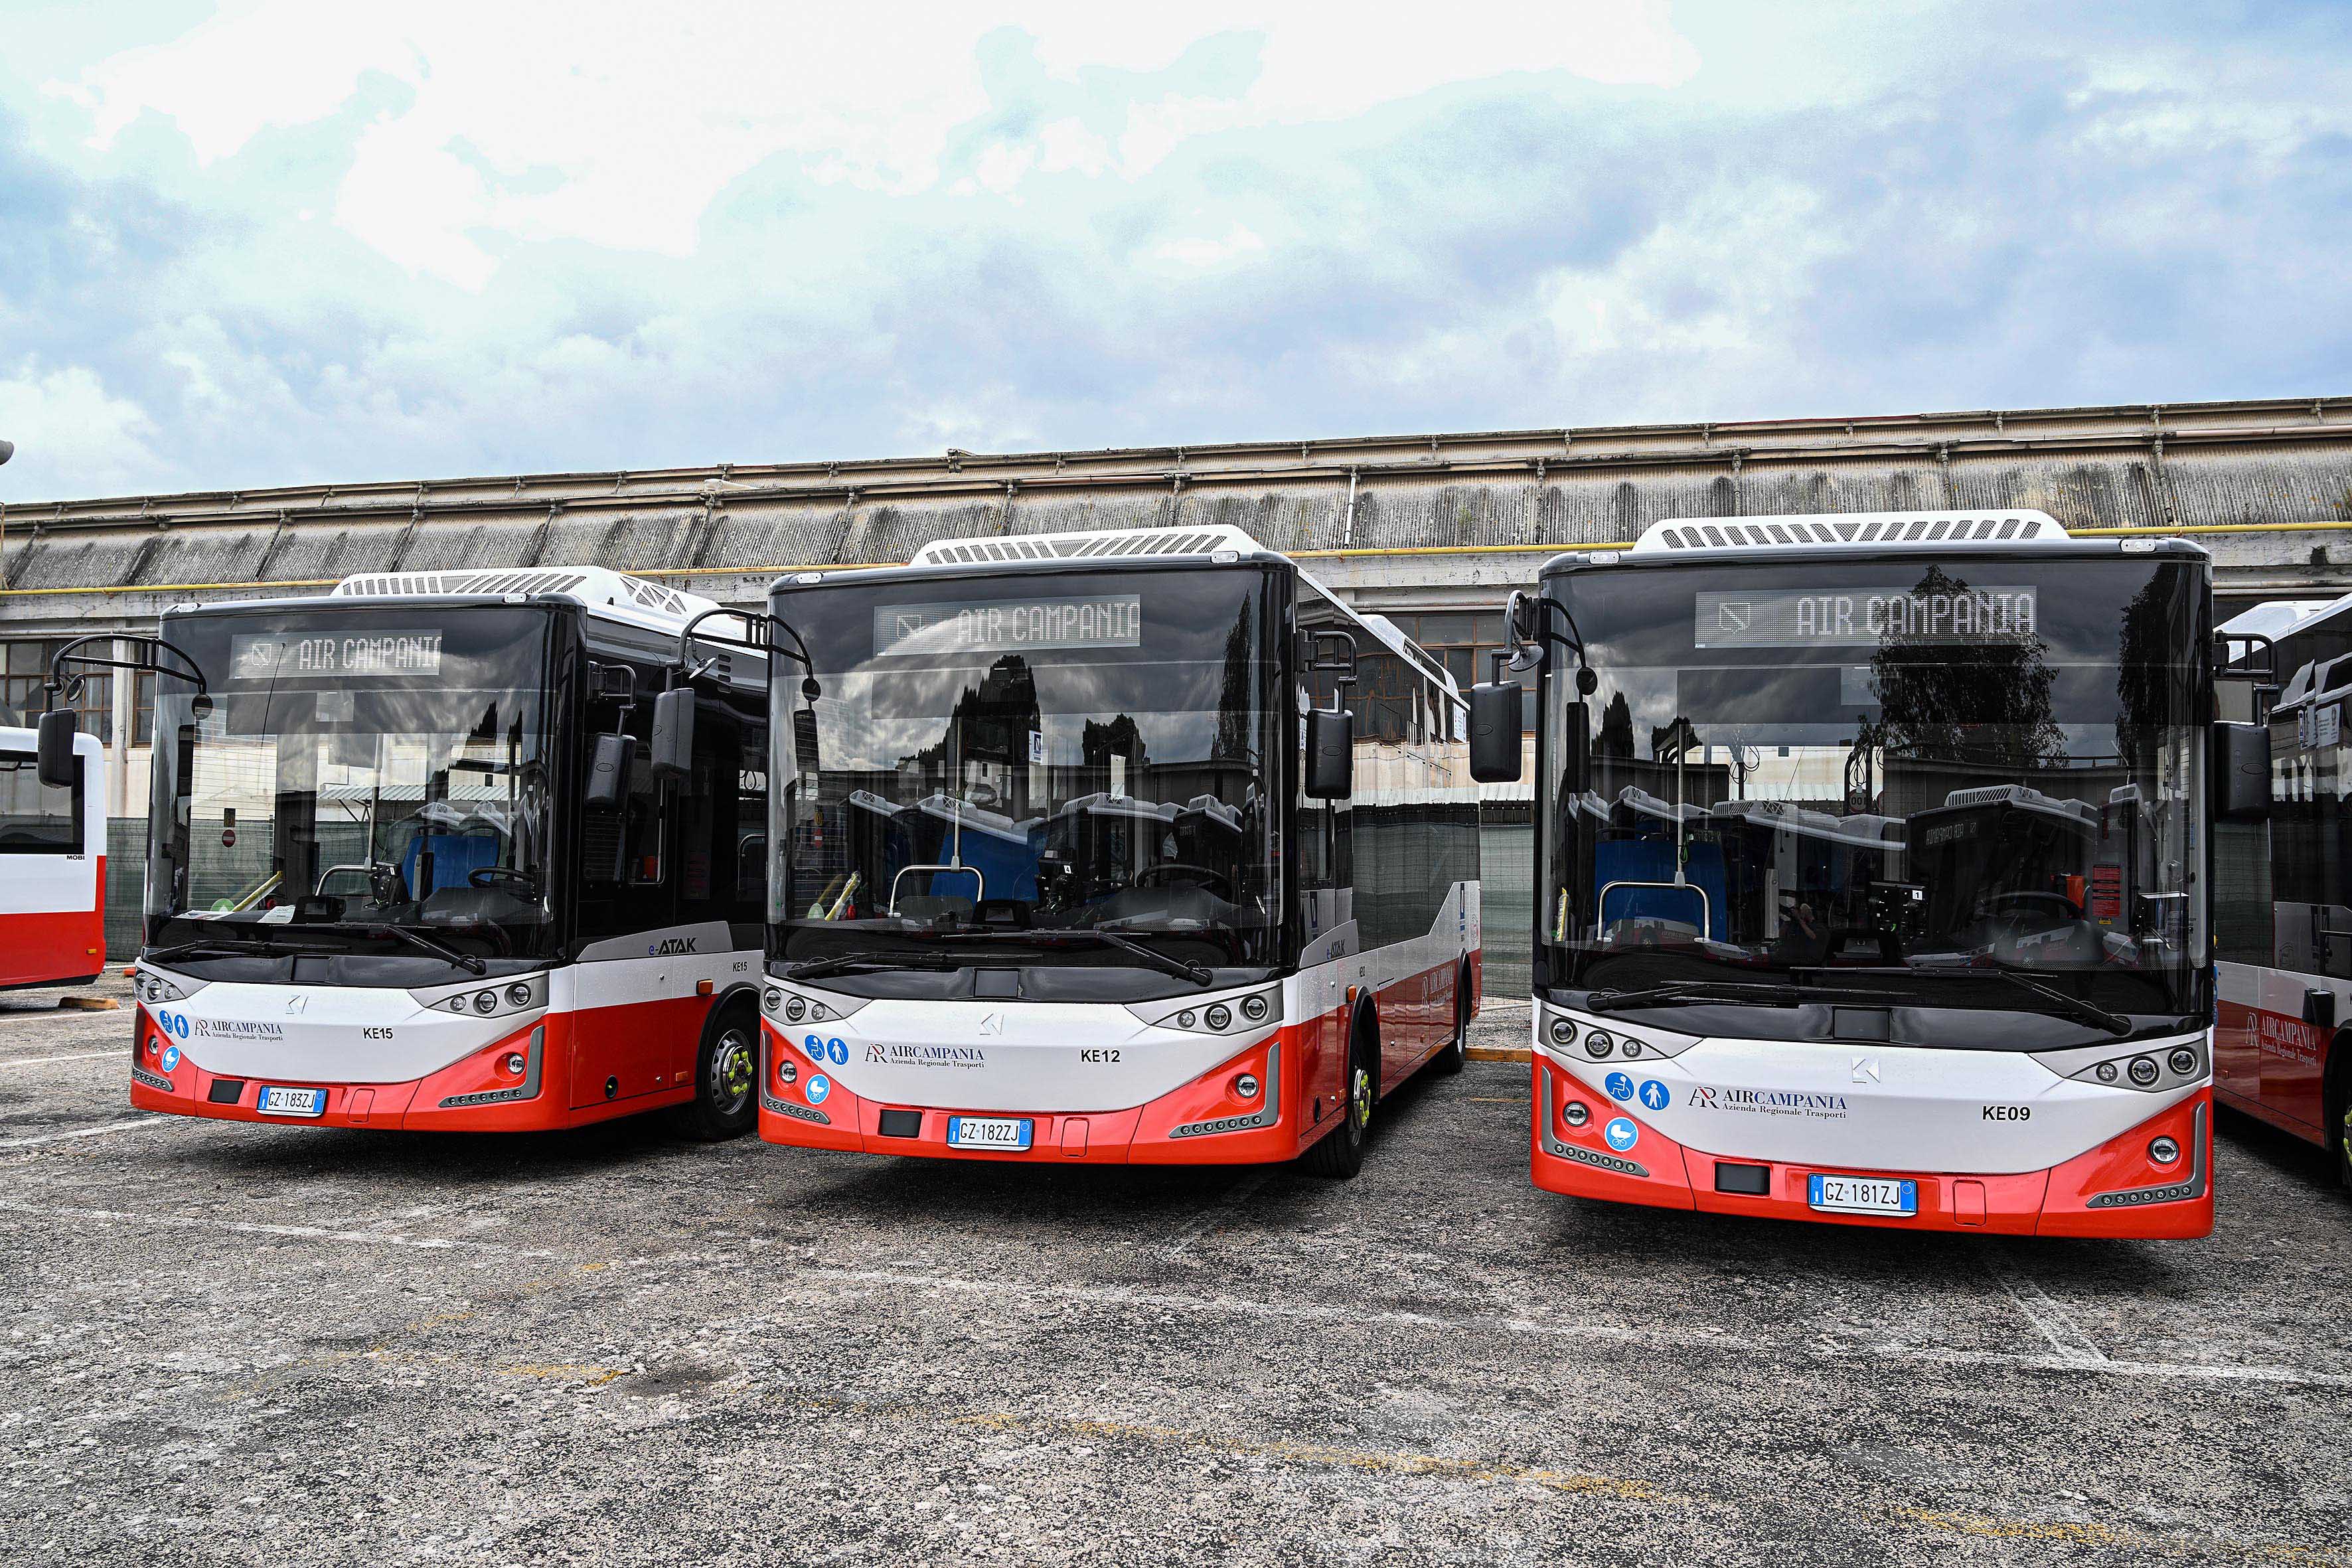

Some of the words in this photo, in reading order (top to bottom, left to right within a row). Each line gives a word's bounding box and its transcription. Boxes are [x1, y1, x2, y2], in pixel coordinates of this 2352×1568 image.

[959, 609, 1002, 643] AIR
[1013, 602, 1140, 641] CAMPANIA
[1796, 596, 1854, 635] AIR
[1867, 594, 2034, 634] CAMPANIA
[299, 639, 335, 669] AIR
[649, 937, 697, 955] e-ATAK
[733, 962, 747, 972] KE15
[212, 1021, 283, 1034] AIRCAMPANIA
[363, 1028, 393, 1039] KE15
[2260, 1015, 2316, 1051] AIRCAMPANIA
[890, 1046, 984, 1060] AIRCAMPANIA
[1081, 1049, 1121, 1063] KE12
[918, 1059, 951, 1068] Regionale
[952, 1060, 984, 1069] Trasporti
[1722, 1089, 1847, 1110] AIRCAMPANIA
[1722, 1103, 1757, 1112] Azienda
[1759, 1105, 1802, 1117] Regionale
[1804, 1108, 1847, 1120] Trasporti
[1982, 1105, 2031, 1121] KE09
